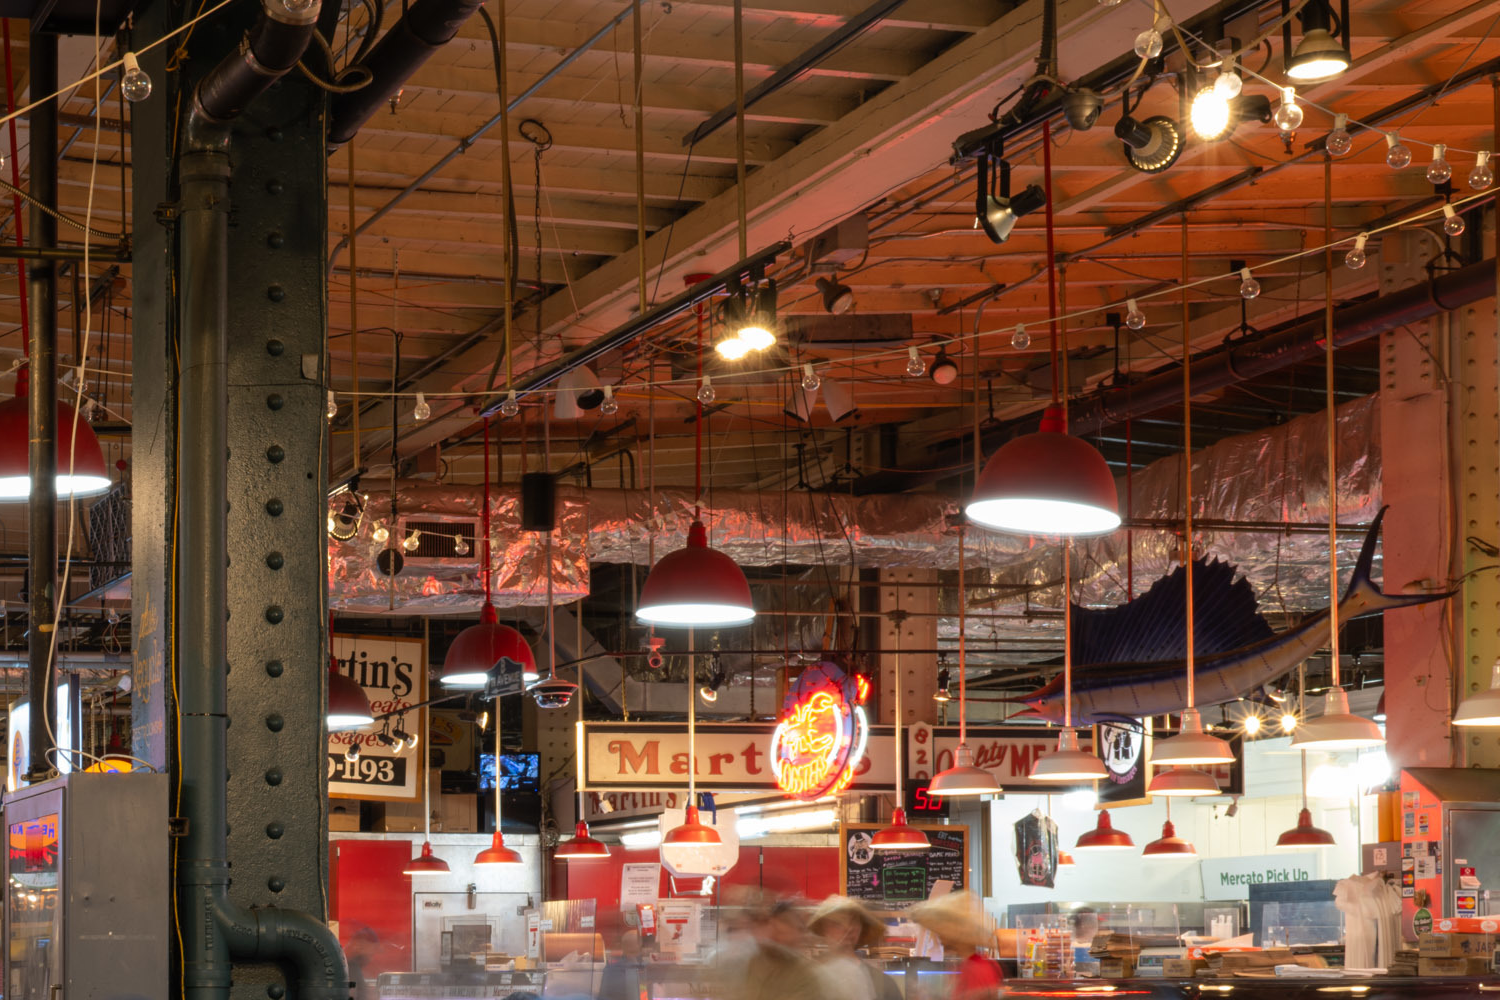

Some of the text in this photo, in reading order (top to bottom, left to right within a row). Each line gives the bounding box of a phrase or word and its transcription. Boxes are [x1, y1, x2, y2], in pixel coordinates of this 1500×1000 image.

[337, 650, 412, 697] rtin's
[368, 696, 413, 716] eats
[328, 758, 394, 783] -1193
[1220, 870, 1264, 886] Mercato
[1266, 868, 1290, 883] Pick
